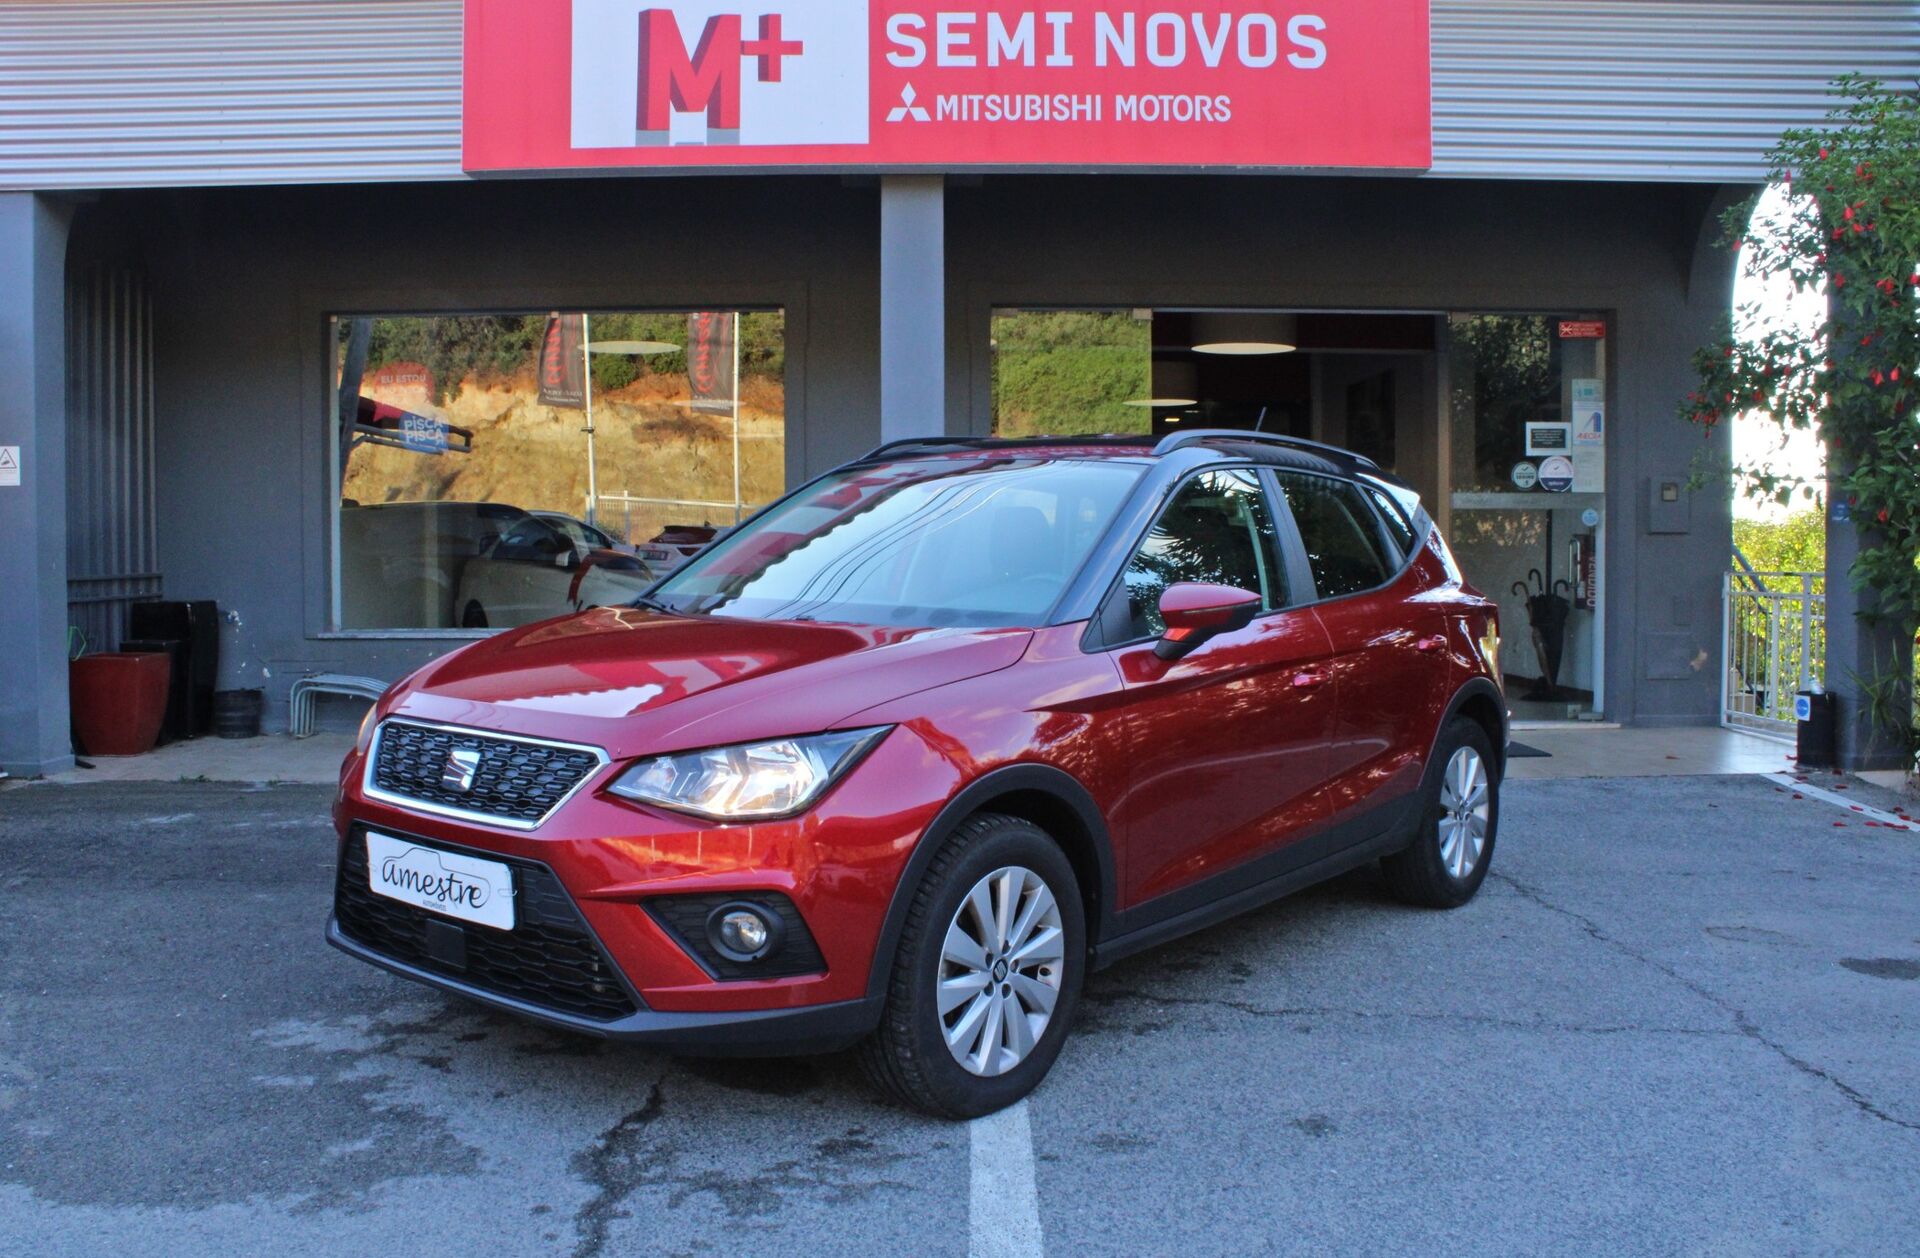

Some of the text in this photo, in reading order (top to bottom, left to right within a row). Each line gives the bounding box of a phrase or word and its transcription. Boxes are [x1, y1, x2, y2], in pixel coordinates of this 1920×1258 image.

[887, 12, 1326, 68] SEMI NOVOS
[937, 95, 1231, 121] MITSUBISHI MOTORS
[380, 375, 393, 384] EU
